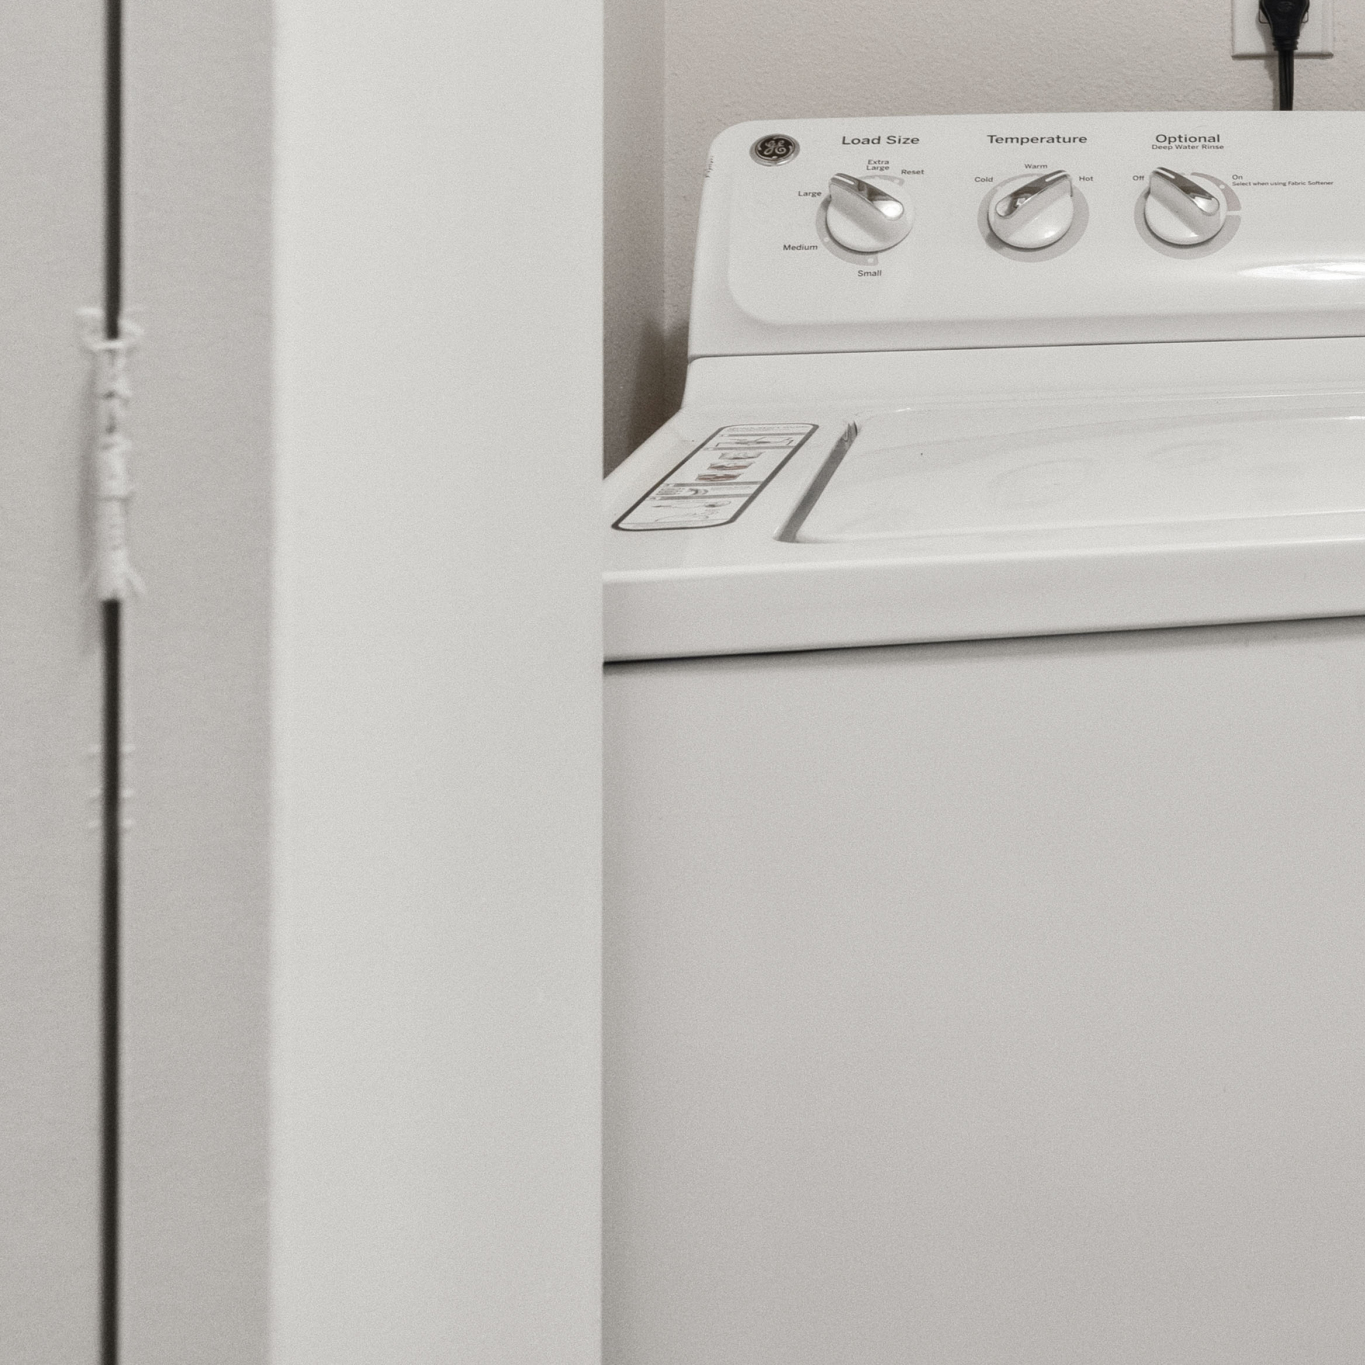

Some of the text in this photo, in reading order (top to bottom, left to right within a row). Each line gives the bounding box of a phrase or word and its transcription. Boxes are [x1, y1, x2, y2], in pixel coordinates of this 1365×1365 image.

[842, 135, 920, 145] Load Size
[986, 134, 1088, 146] Temperature
[1156, 134, 1220, 145] Optional
